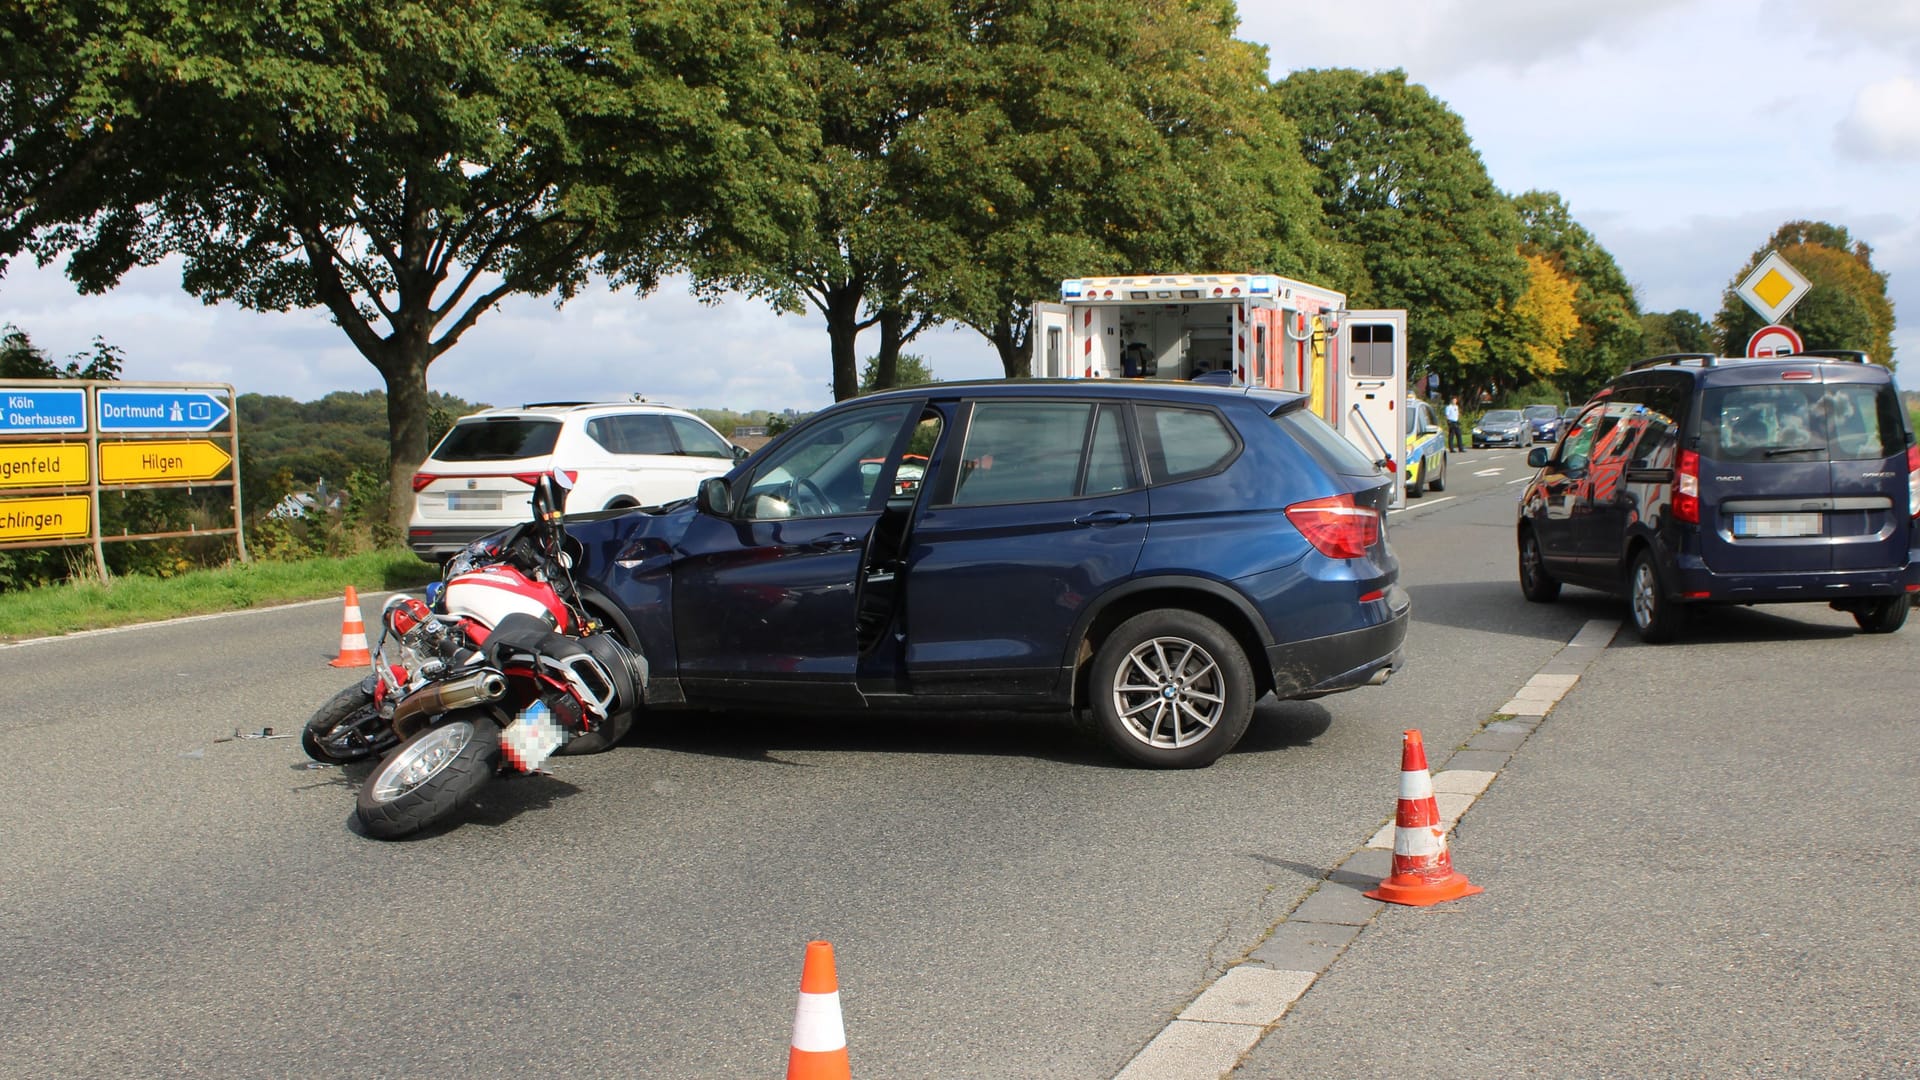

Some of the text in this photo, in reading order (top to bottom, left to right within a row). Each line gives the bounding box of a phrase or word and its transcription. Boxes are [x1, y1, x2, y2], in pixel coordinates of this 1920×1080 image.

[9, 396, 34, 409] Köln
[104, 403, 165, 418] Dortmund
[10, 412, 76, 425] Oberhausen
[0, 456, 60, 479] genfeld
[142, 454, 183, 473] Hilgen
